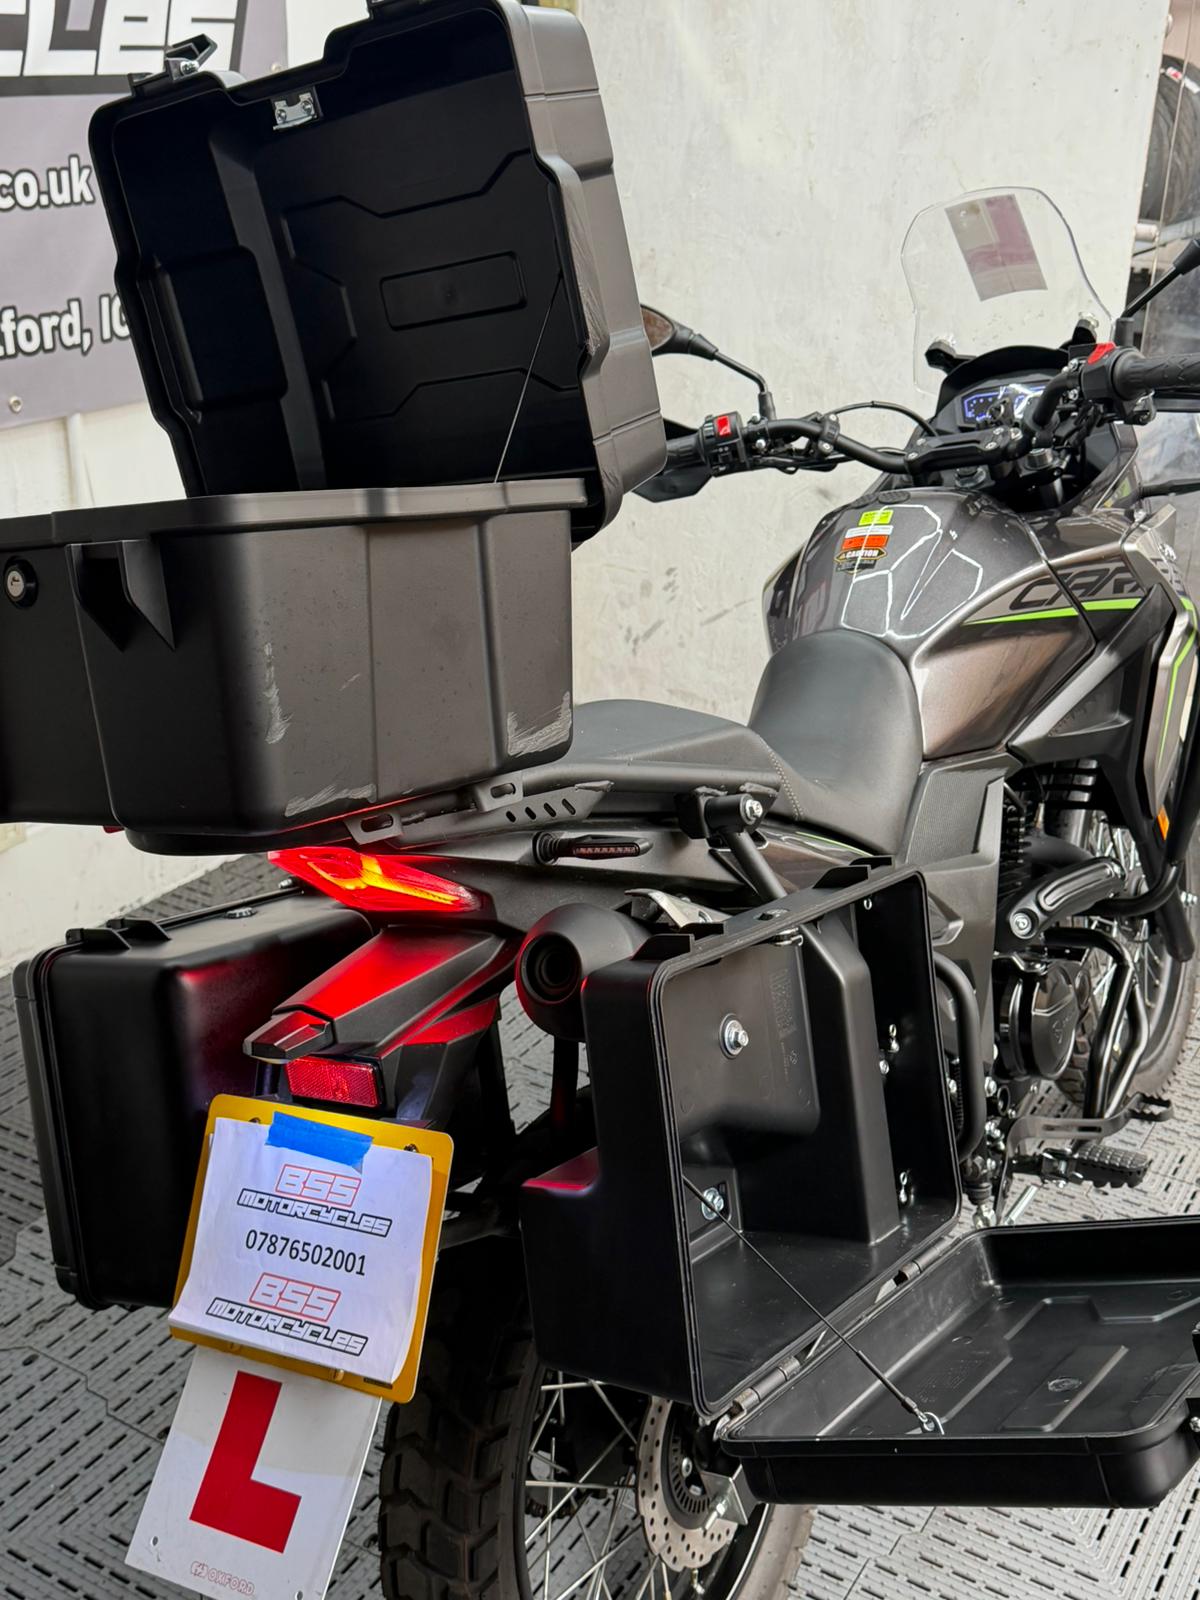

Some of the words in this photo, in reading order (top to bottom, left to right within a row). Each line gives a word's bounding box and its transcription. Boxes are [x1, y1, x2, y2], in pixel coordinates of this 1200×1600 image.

[0, 297, 92, 359] ford,
[275, 1164, 361, 1208] BSS
[245, 1229, 367, 1276] 07876502001
[249, 1272, 341, 1322] BSS
[189, 1370, 302, 1554] L
[207, 1567, 256, 1596] OXFORD
